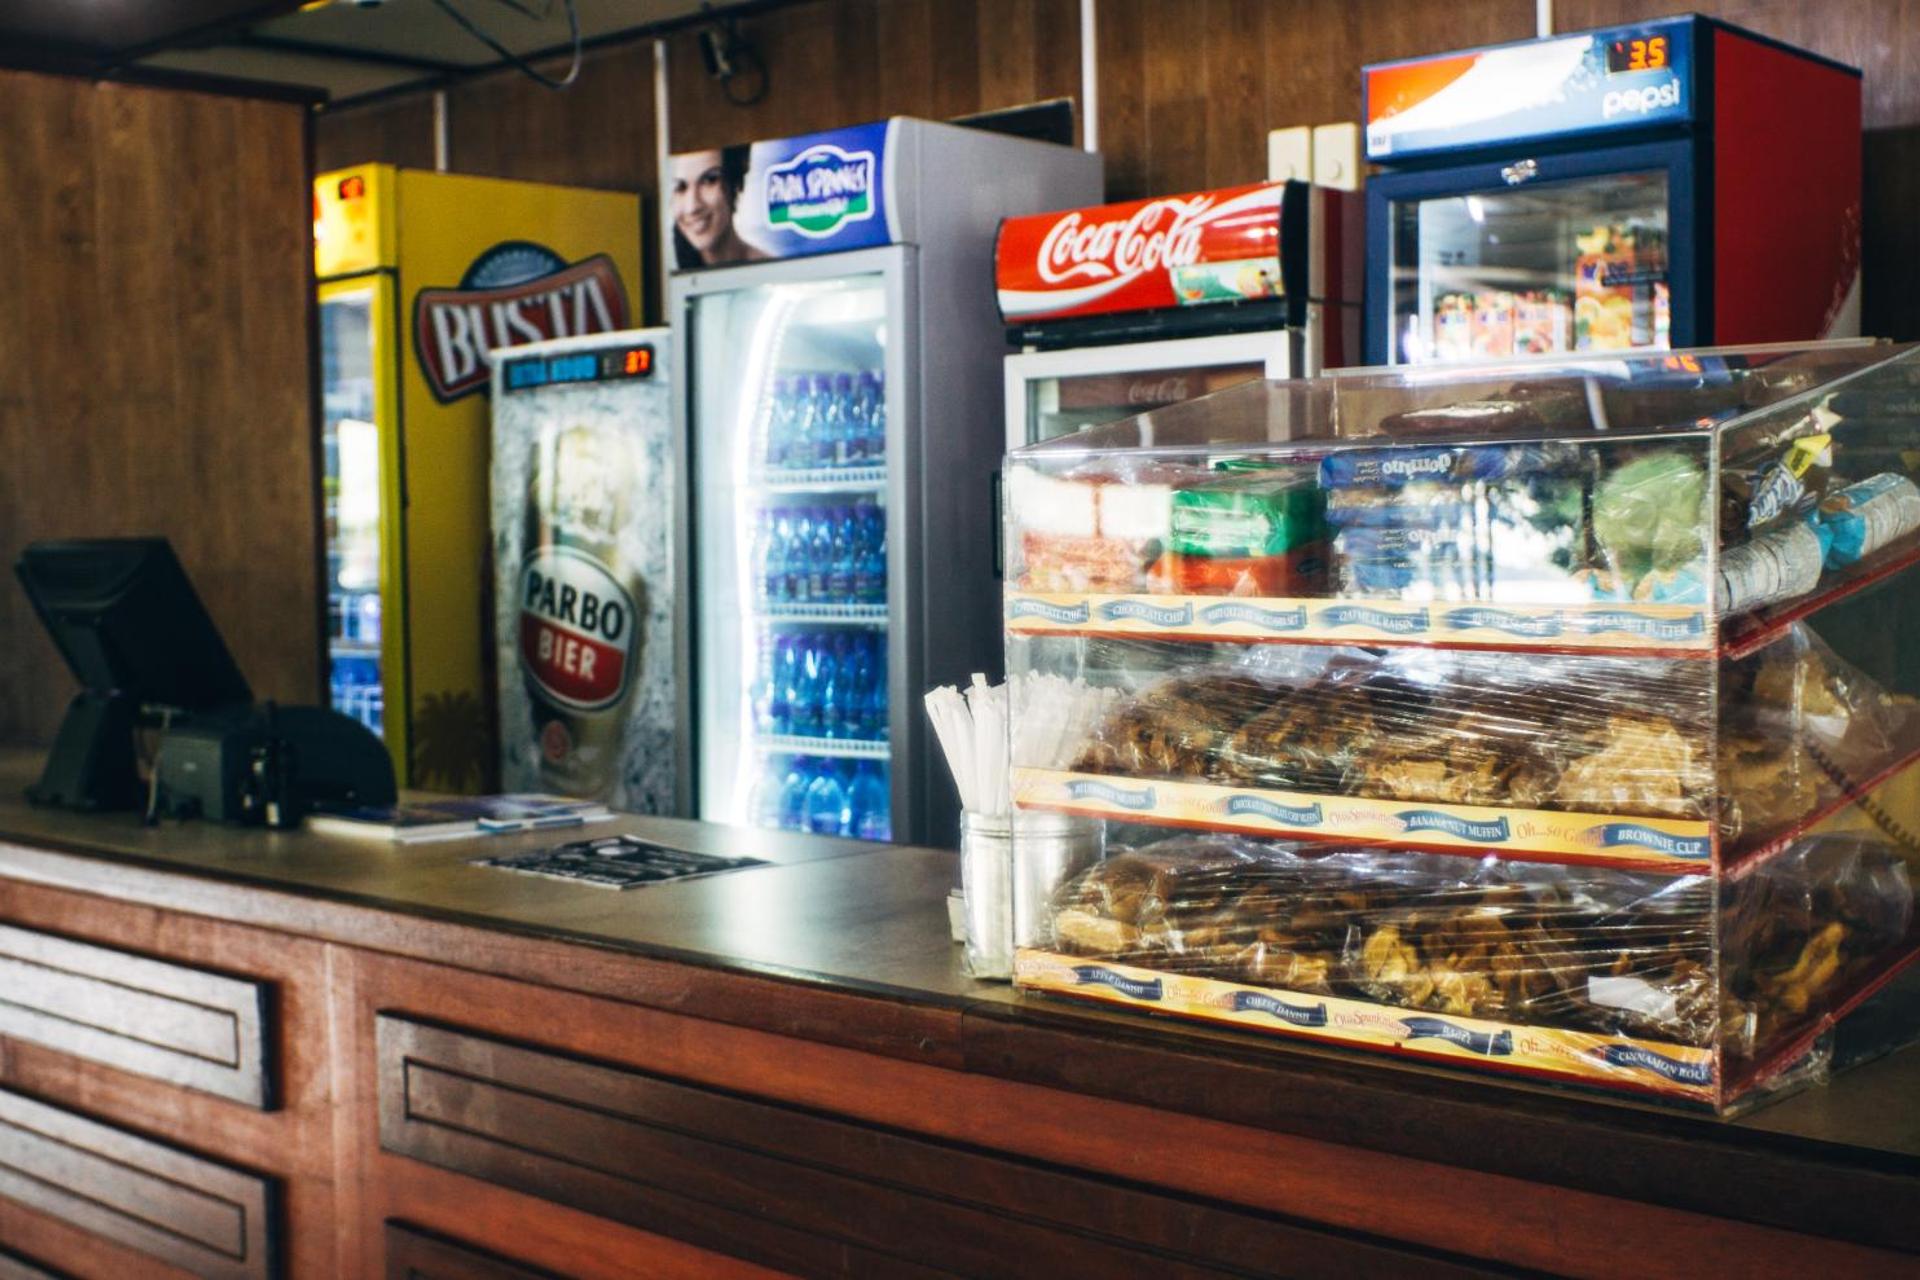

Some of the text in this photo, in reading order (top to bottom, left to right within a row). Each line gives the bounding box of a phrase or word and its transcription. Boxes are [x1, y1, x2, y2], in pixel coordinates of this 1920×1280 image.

[1627, 36, 1667, 70] 35
[1602, 78, 1681, 119] pepsi
[1036, 193, 1216, 284] Coca-Cola
[525, 569, 624, 641] PARBO
[538, 627, 597, 682] BIER
[1467, 824, 1502, 838] MUFFIN
[1617, 829, 1674, 852] BROWNIE
[1675, 840, 1702, 855] CUP
[1115, 977, 1144, 995] DANISH
[1245, 995, 1276, 1012] CHEESE
[1276, 1004, 1310, 1022] DANISH
[1617, 1050, 1678, 1075] CINNAMON
